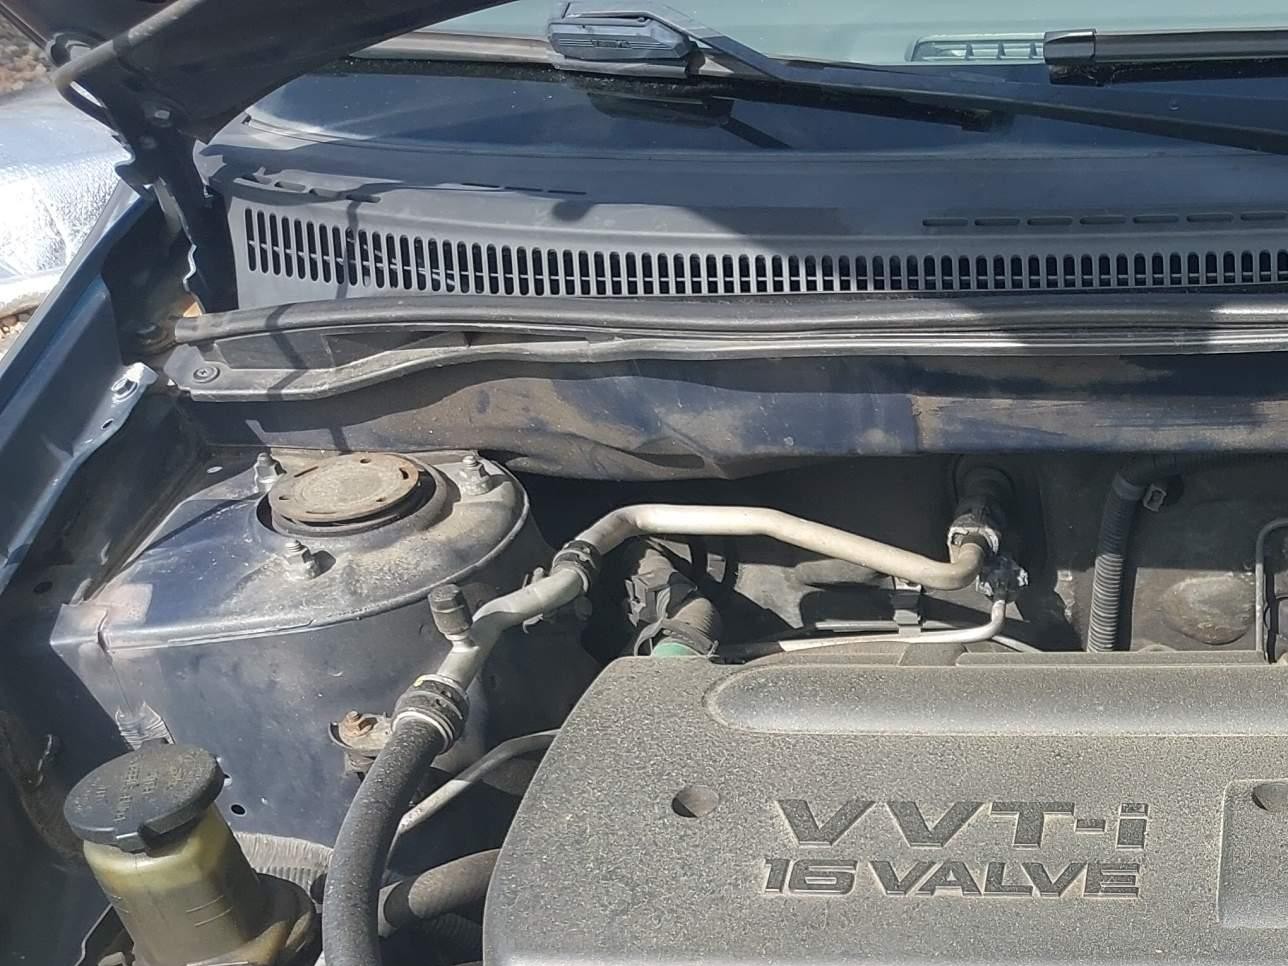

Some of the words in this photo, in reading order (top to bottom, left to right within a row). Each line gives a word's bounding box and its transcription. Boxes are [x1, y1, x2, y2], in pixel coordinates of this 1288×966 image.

[774, 799, 1149, 850] VVT-i
[763, 859, 858, 895] 16
[867, 860, 1142, 898] VALVE
